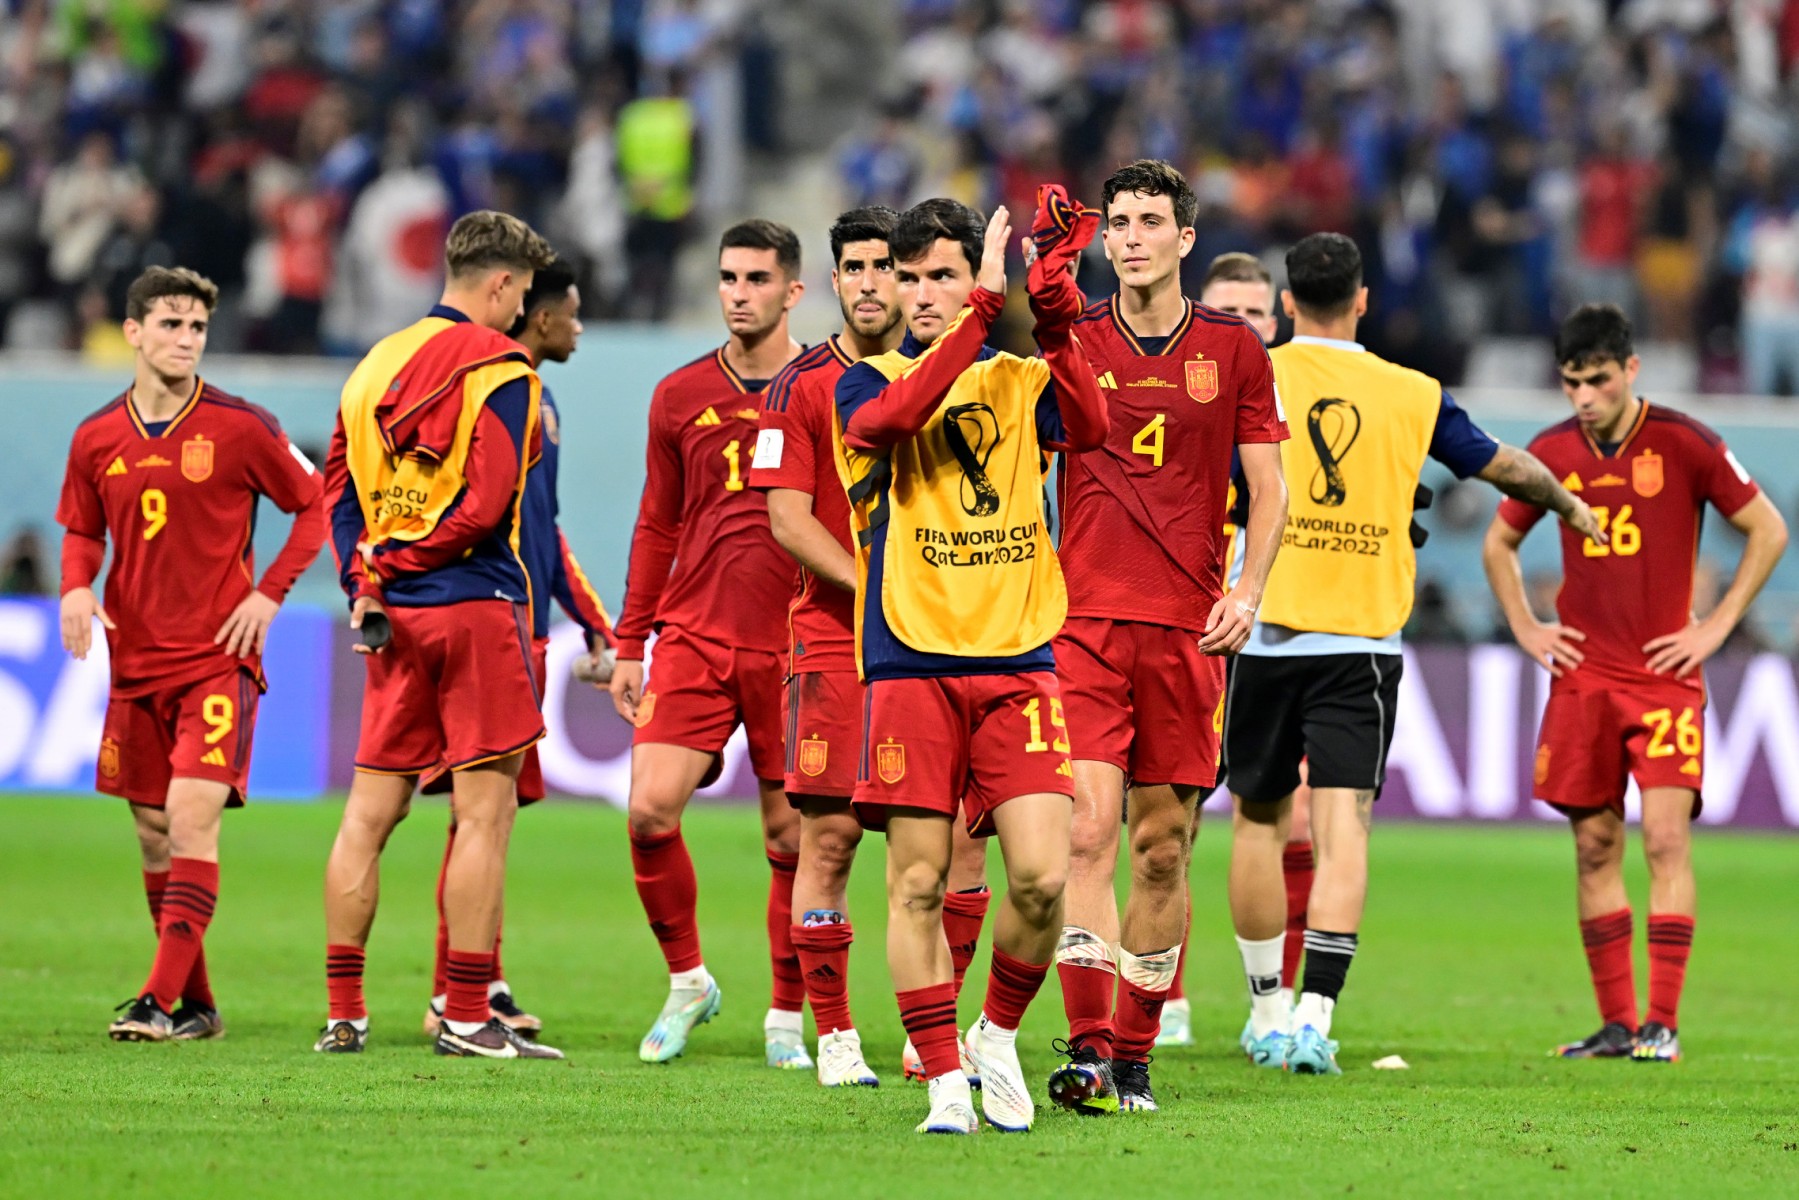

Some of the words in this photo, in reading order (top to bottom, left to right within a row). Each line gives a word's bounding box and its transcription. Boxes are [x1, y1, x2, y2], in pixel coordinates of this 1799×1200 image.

[722, 439, 756, 492] 1
[1132, 413, 1165, 467] 4
[141, 488, 167, 540] 9
[406, 489, 428, 504] CU
[915, 527, 948, 545] FIFA
[1280, 532, 1380, 556] atar2022
[1296, 517, 1356, 535] WORLD
[1360, 523, 1389, 538] CUP
[1583, 504, 1641, 557] 26
[203, 694, 234, 744] 9
[1021, 696, 1071, 754] 15
[1641, 706, 1701, 758] 26
